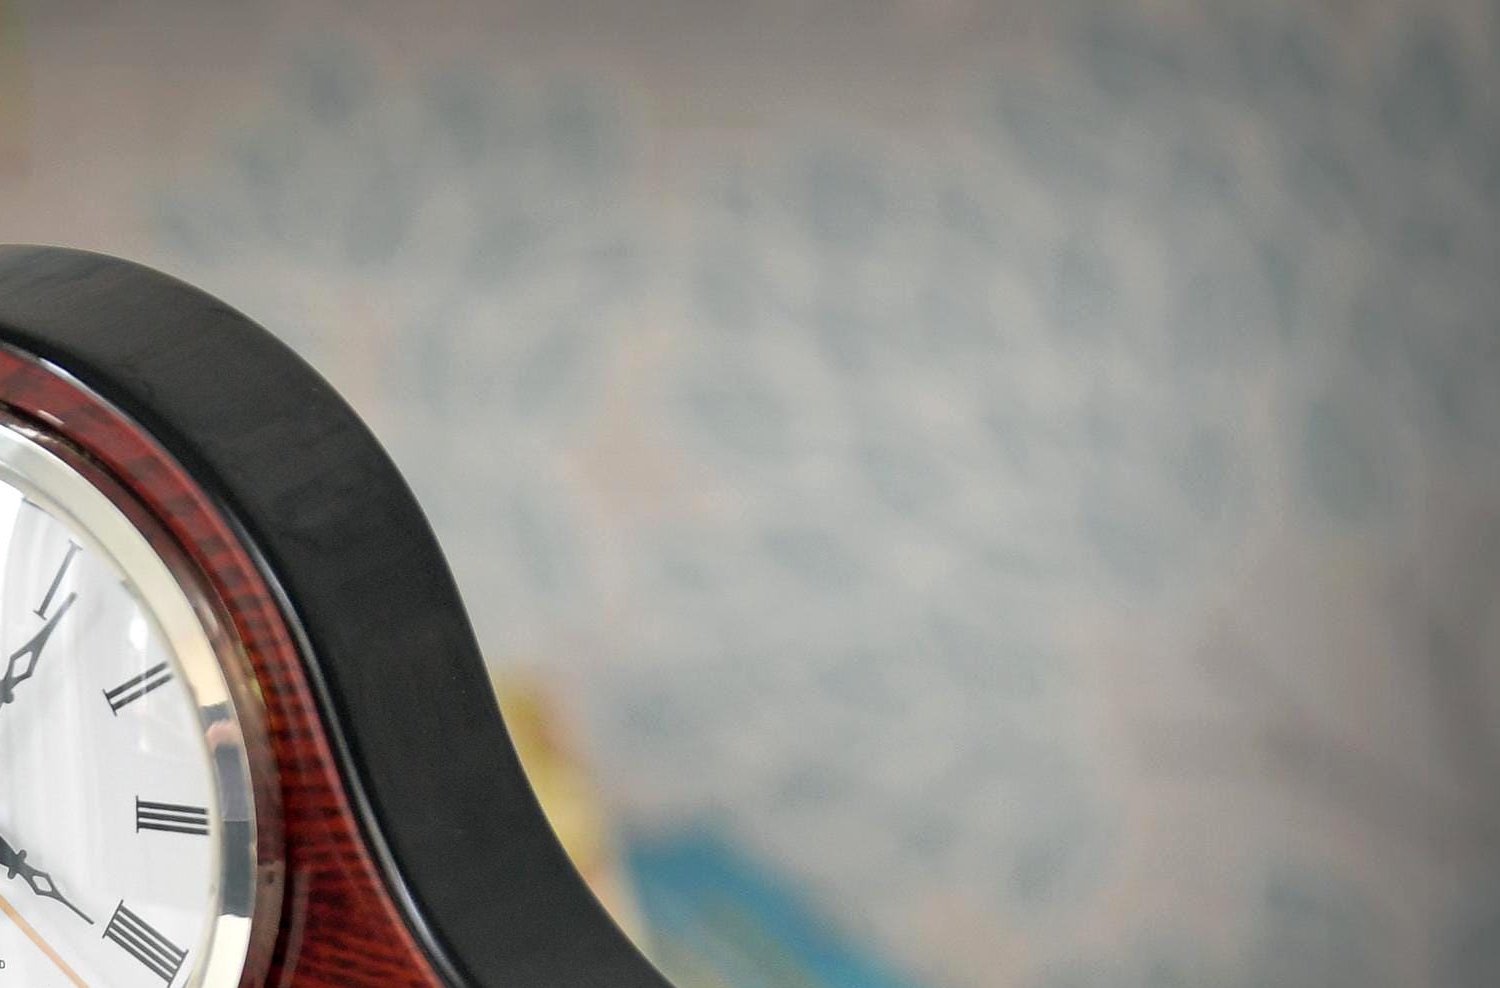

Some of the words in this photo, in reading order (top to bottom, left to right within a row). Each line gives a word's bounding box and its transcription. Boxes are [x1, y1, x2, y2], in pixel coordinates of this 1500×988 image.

[102, 661, 174, 716] II
[136, 794, 210, 836] III
[102, 899, 190, 988] IIII
